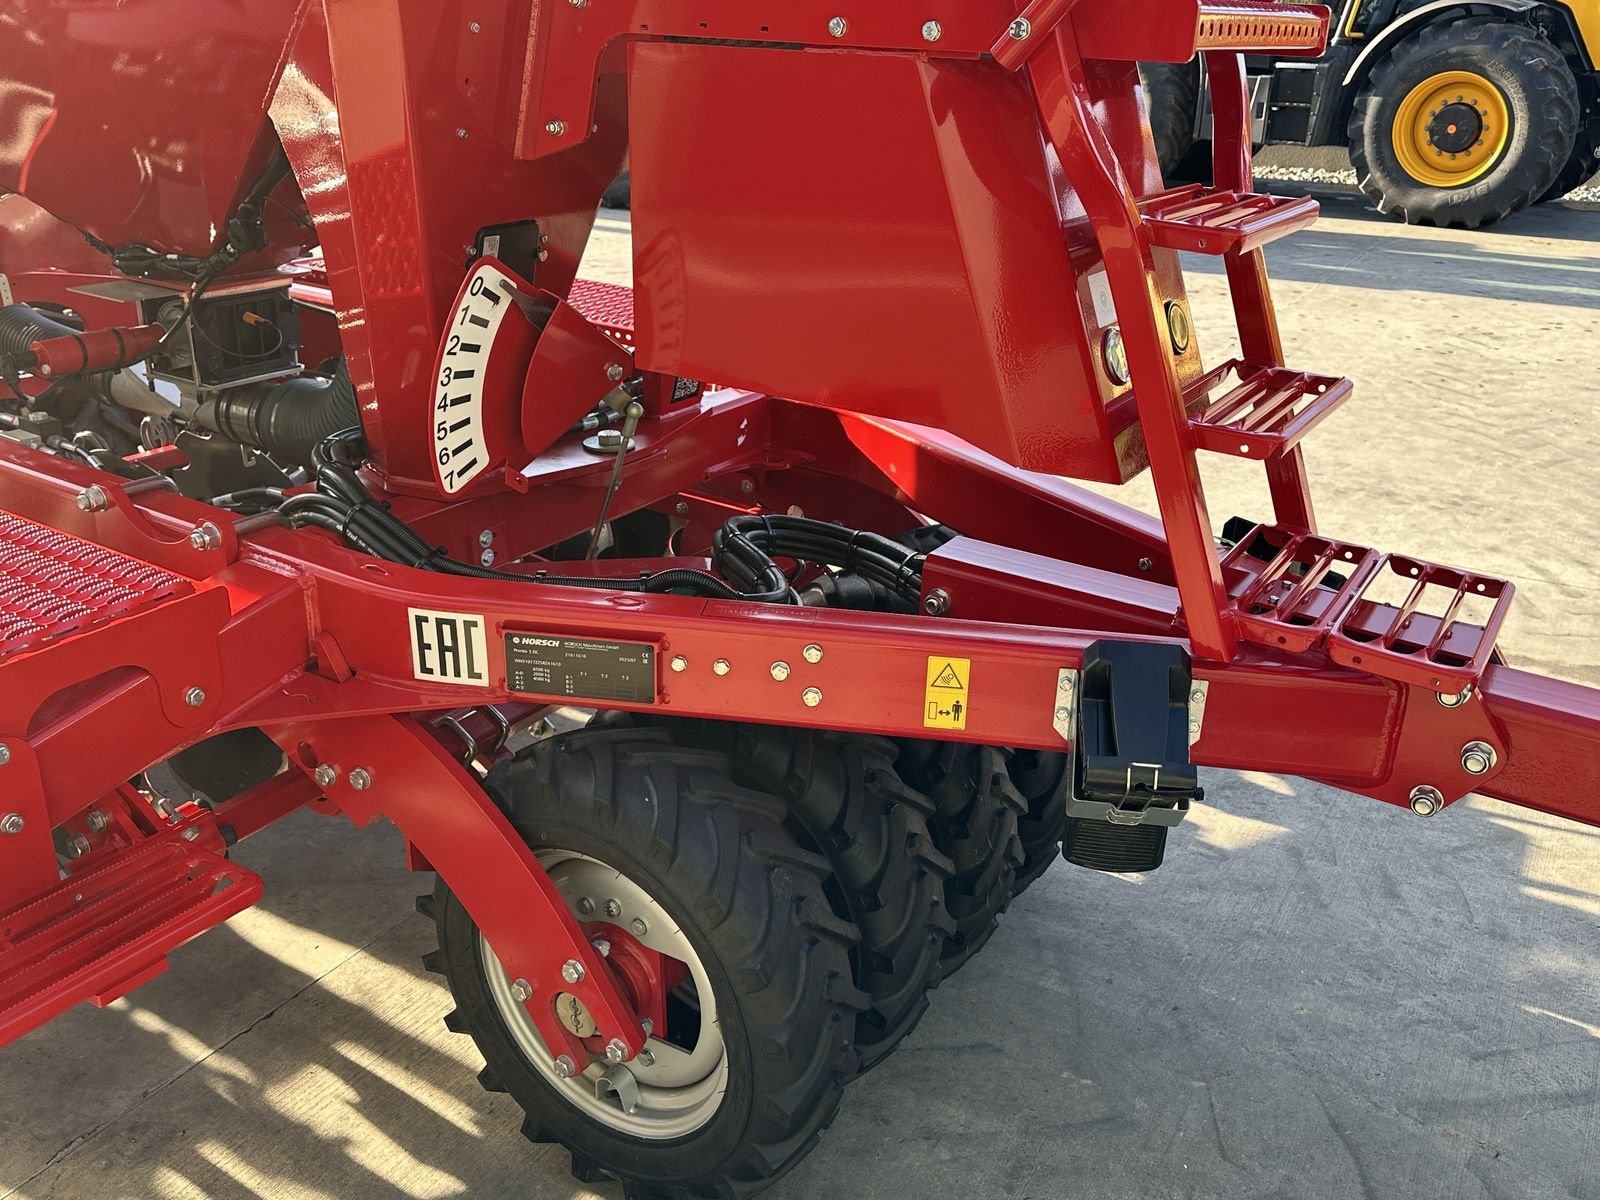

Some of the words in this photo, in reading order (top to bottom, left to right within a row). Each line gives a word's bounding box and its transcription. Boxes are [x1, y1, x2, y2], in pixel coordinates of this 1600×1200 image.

[470, 276, 484, 296] 0
[460, 305, 471, 326] 1
[446, 335, 461, 356] 2
[440, 367, 452, 387] 3
[437, 393, 449, 413] 4
[437, 420, 449, 441] 5
[438, 445, 450, 465] 6
[444, 471, 455, 490] 7
[415, 615, 483, 680] EAC
[522, 637, 560, 647] HORSCH
